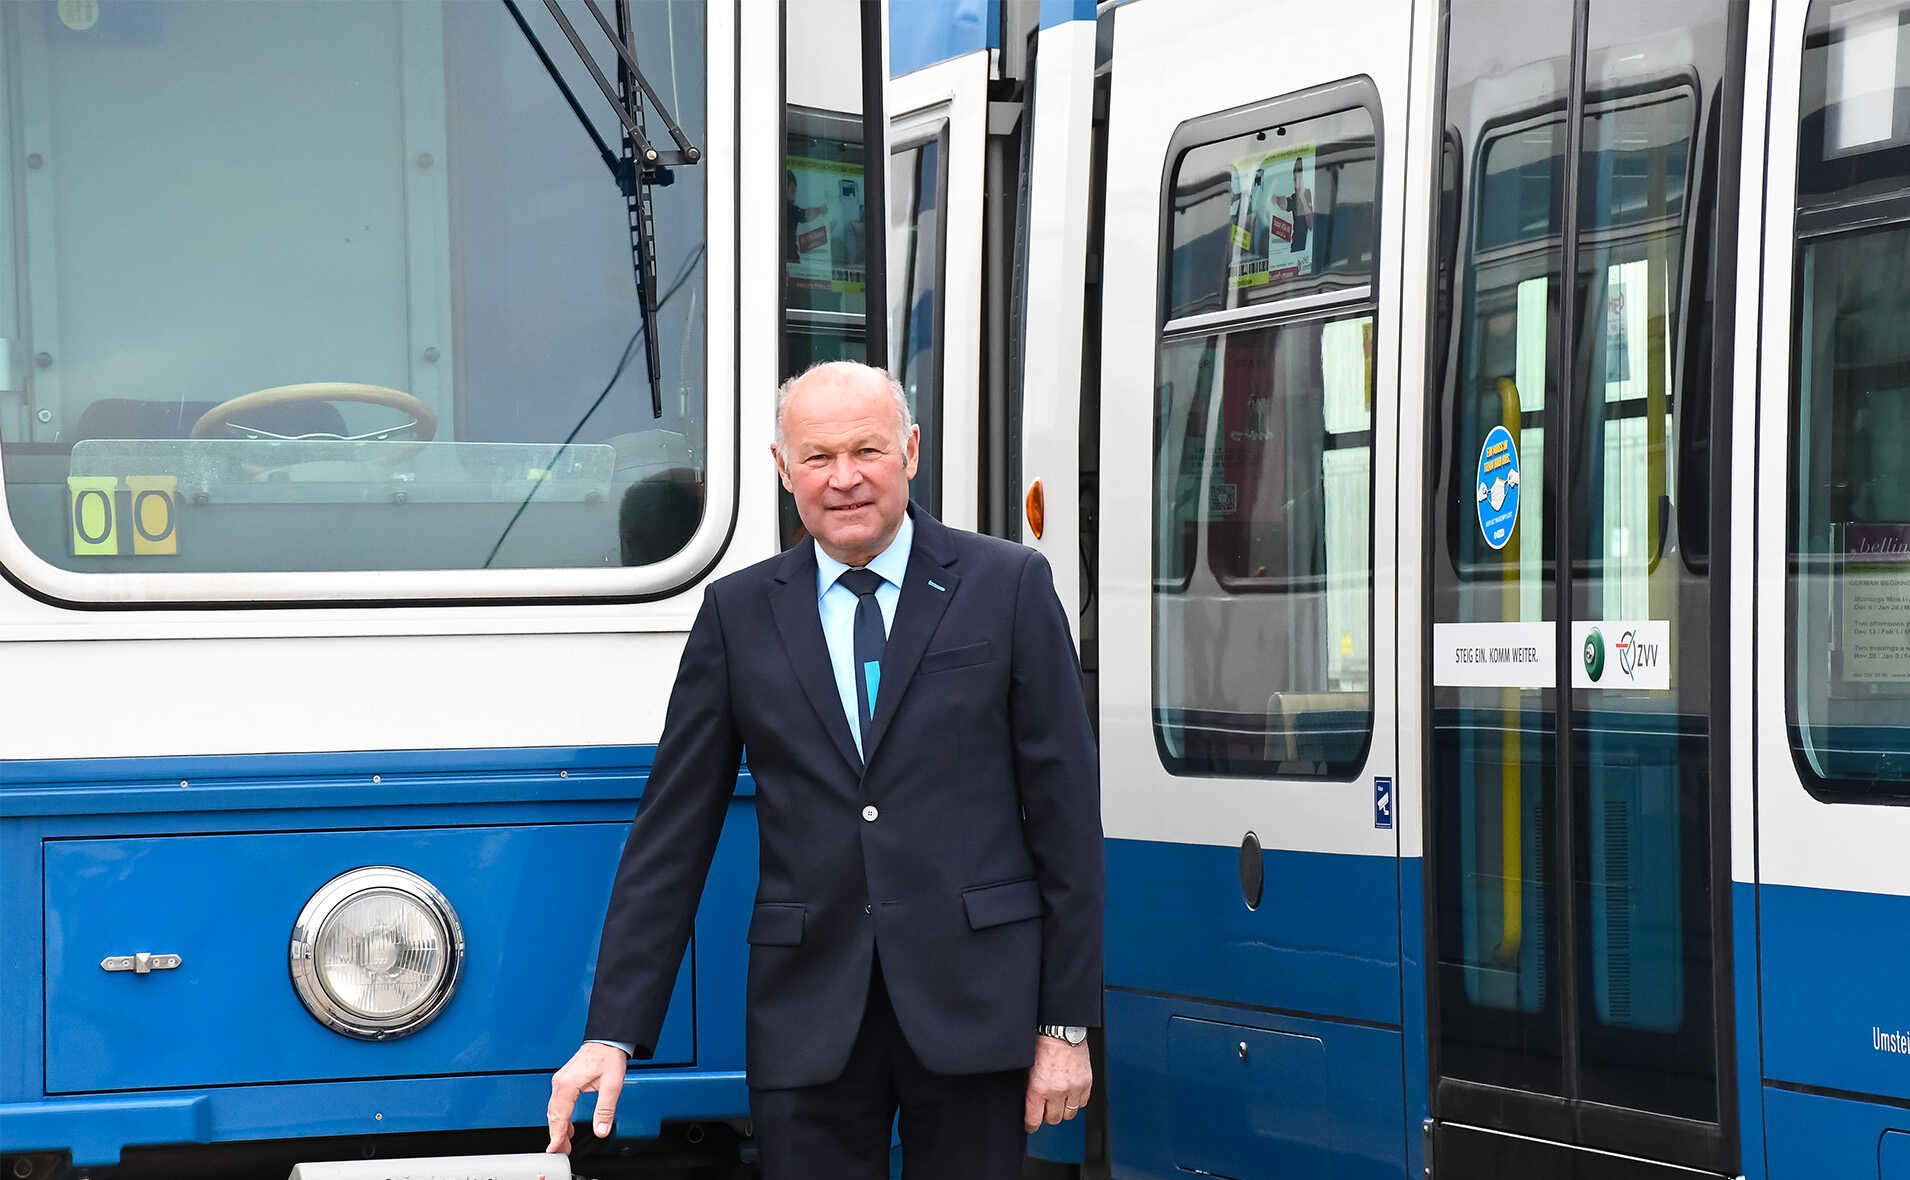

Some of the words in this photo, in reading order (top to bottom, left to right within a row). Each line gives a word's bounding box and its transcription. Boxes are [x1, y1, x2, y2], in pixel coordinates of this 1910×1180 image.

[1455, 647, 1474, 664] STEIG
[1475, 647, 1488, 664] EIN.
[1489, 647, 1511, 664] KOMM
[1512, 647, 1539, 664] WEITER.
[1637, 643, 1658, 667] ZVV
[1872, 1026, 1910, 1055] Umstei
